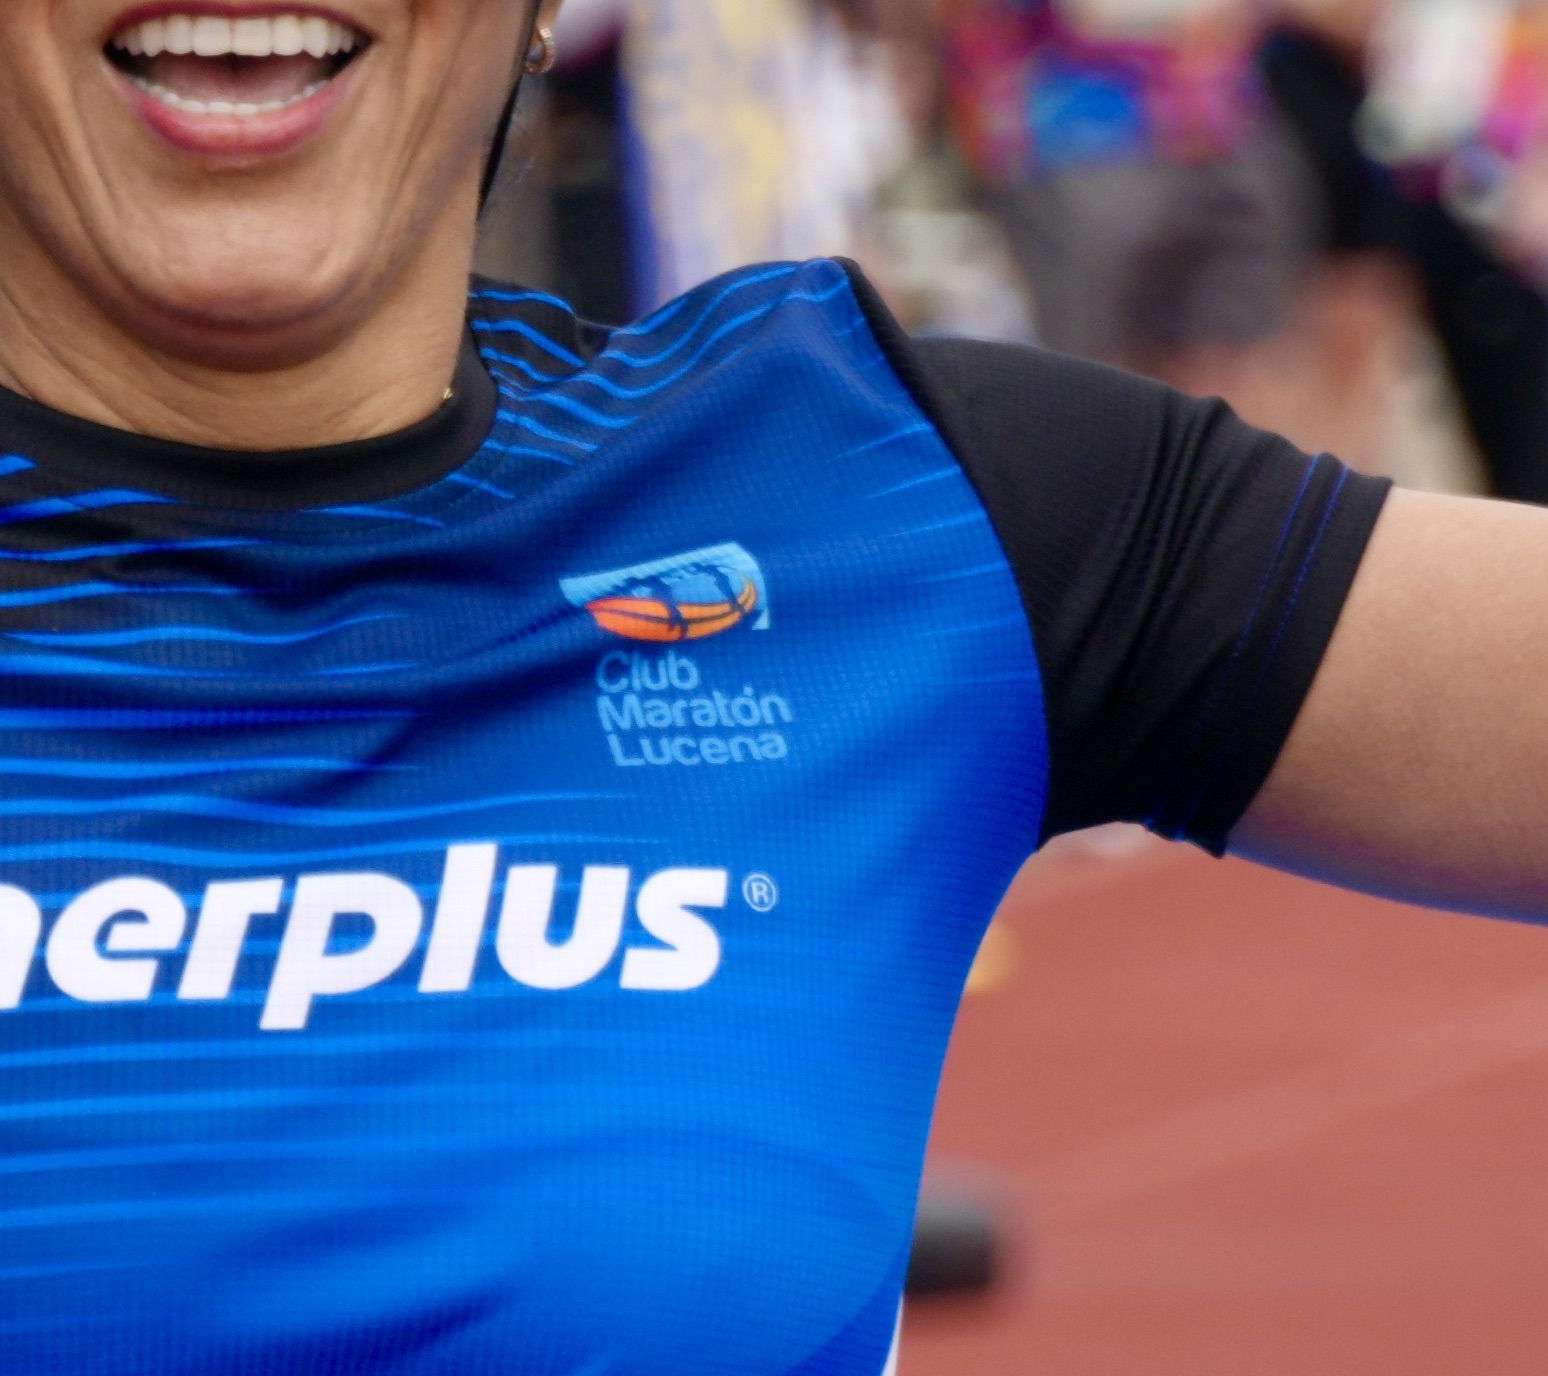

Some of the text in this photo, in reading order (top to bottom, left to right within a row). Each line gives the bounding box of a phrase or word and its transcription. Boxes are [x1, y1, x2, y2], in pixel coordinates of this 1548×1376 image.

[596, 649, 701, 694] Club
[596, 686, 793, 732] Maratón
[606, 731, 789, 767] Lucena
